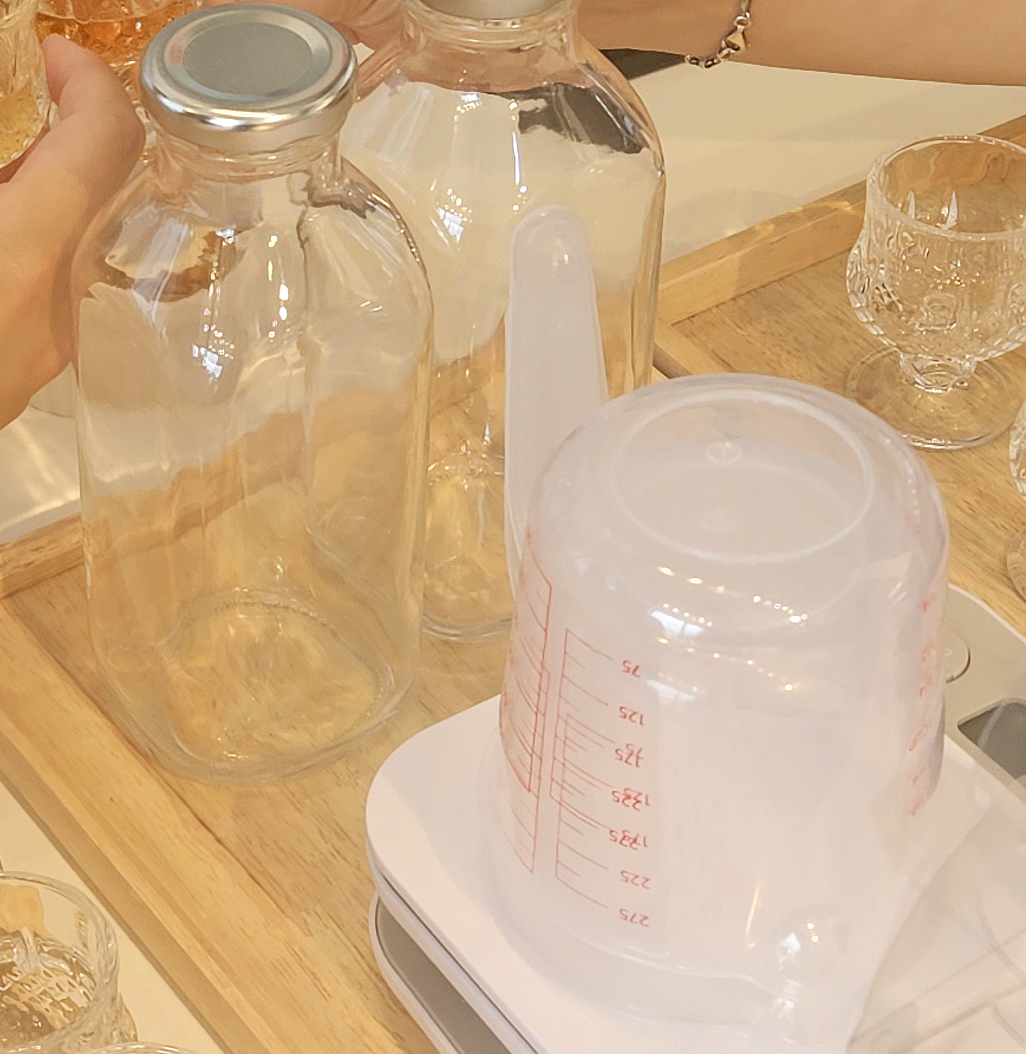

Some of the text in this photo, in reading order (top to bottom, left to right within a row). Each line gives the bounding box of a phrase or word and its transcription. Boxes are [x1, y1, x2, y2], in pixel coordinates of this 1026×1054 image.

[622, 660, 641, 677] 75
[619, 706, 645, 725] 125
[620, 870, 650, 889] 225
[619, 908, 649, 927] 275
